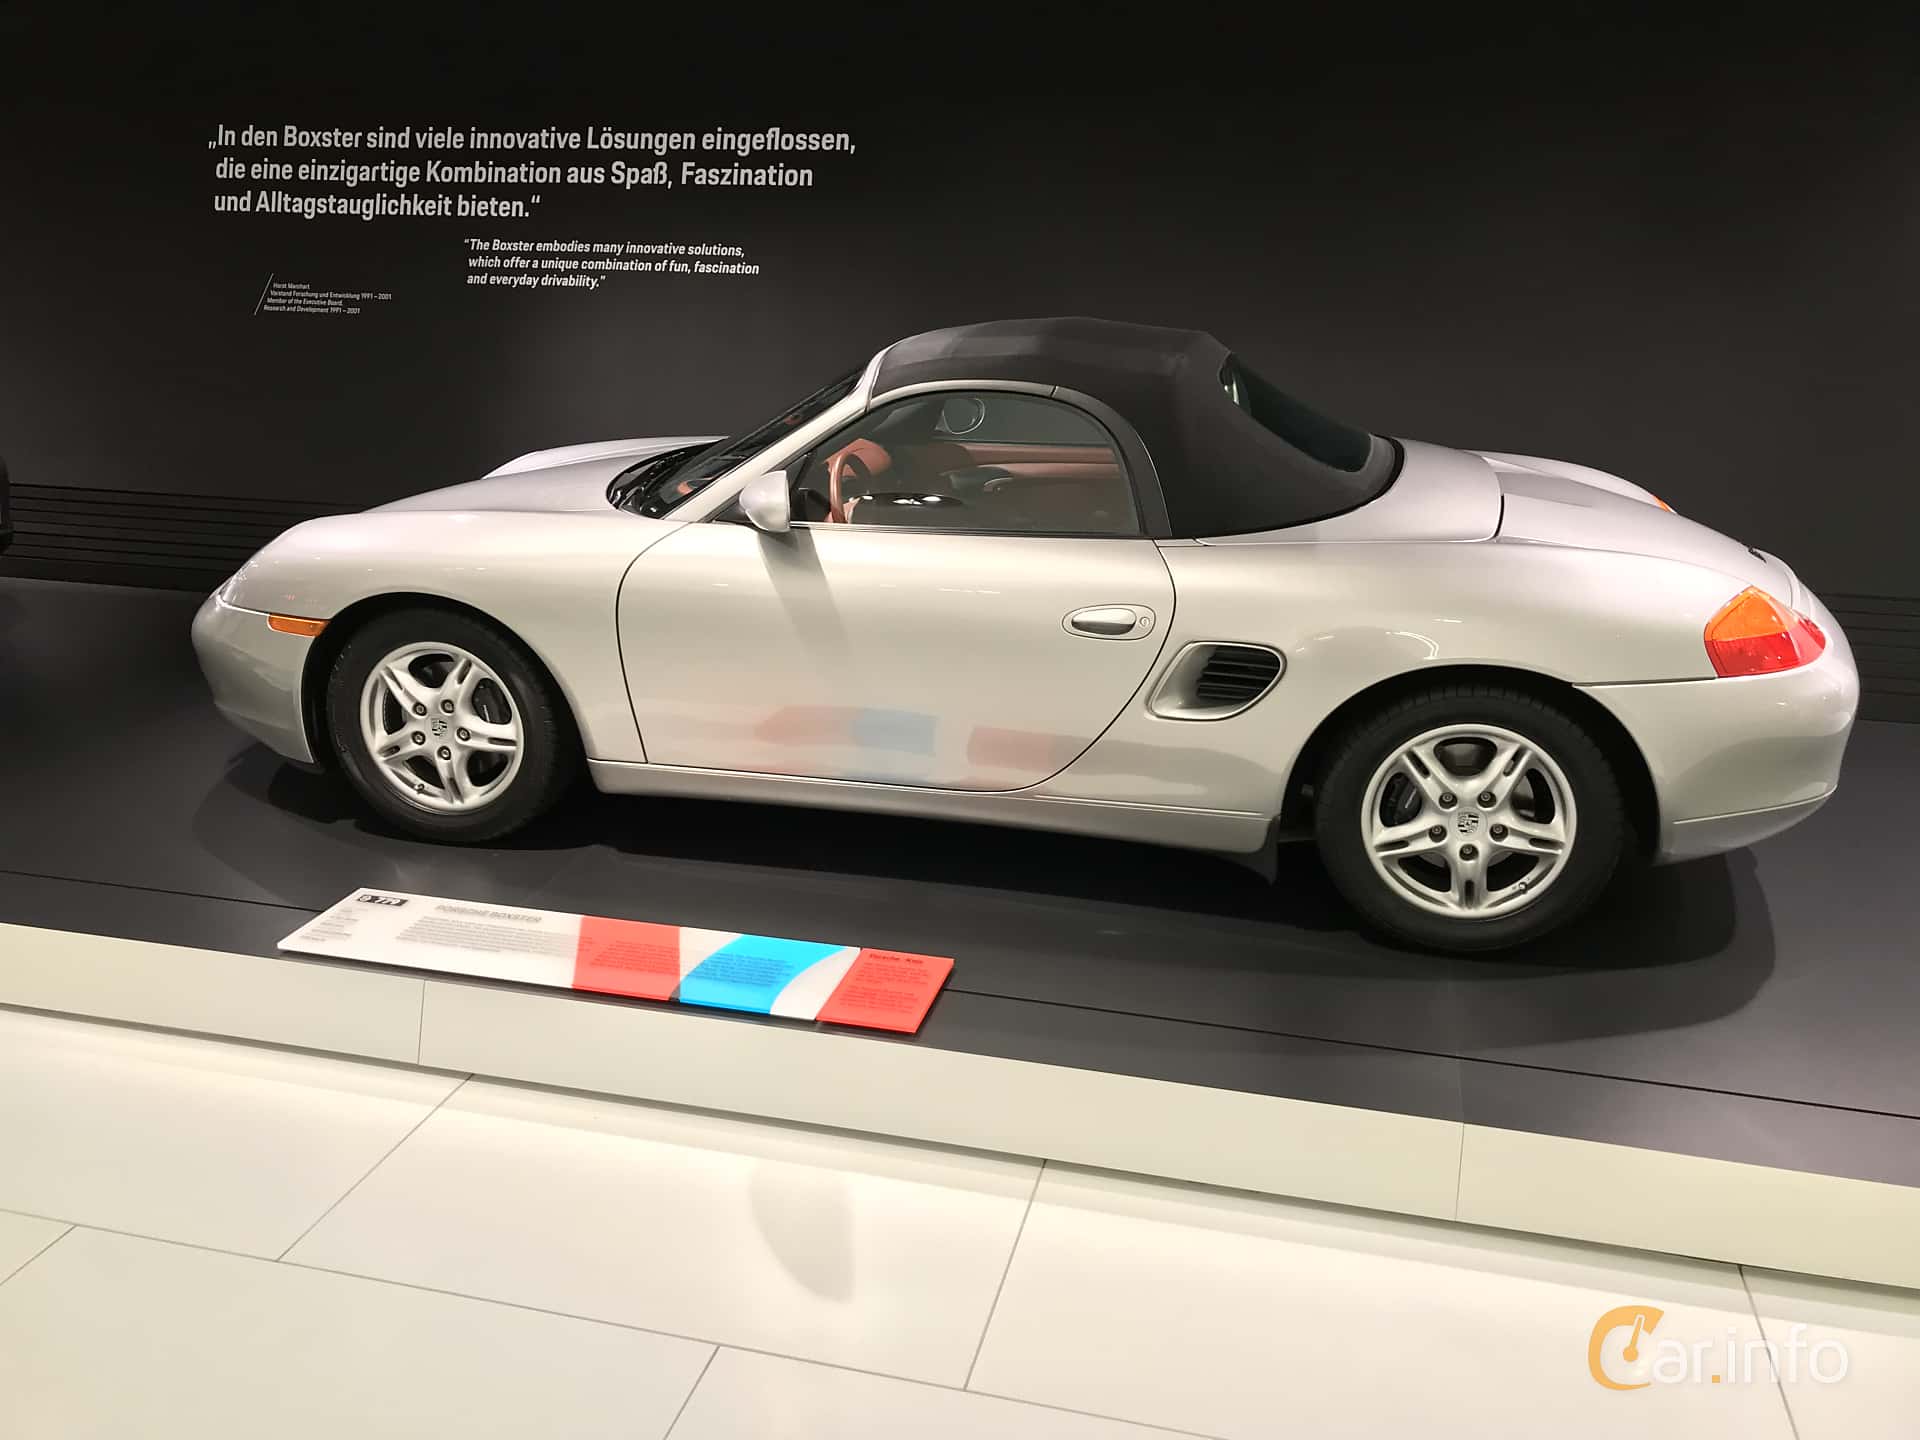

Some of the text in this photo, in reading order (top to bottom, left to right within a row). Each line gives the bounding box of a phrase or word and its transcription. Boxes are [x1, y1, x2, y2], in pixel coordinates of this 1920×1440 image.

[241, 125, 278, 148] den
[283, 125, 363, 148] Boxster
[366, 127, 411, 149] sind
[415, 127, 465, 150] viele
[470, 127, 581, 149] innovative
[587, 126, 696, 156] Lösungen
[701, 127, 856, 158] eingeflossen,
[215, 157, 814, 190] die eine einzigartige Kombination aus Spaß, Faszination
[214, 191, 251, 213] und
[255, 191, 452, 221] Alltagstauglichkeit
[492, 239, 535, 252] Boxster
[536, 240, 591, 254] embodies
[592, 242, 624, 256] many
[626, 241, 686, 256] innovative
[687, 243, 745, 258] solutions,
[468, 256, 759, 275] which offer a unique combination of fun, fascination
[467, 273, 487, 285] and
[489, 274, 540, 288] everyday
